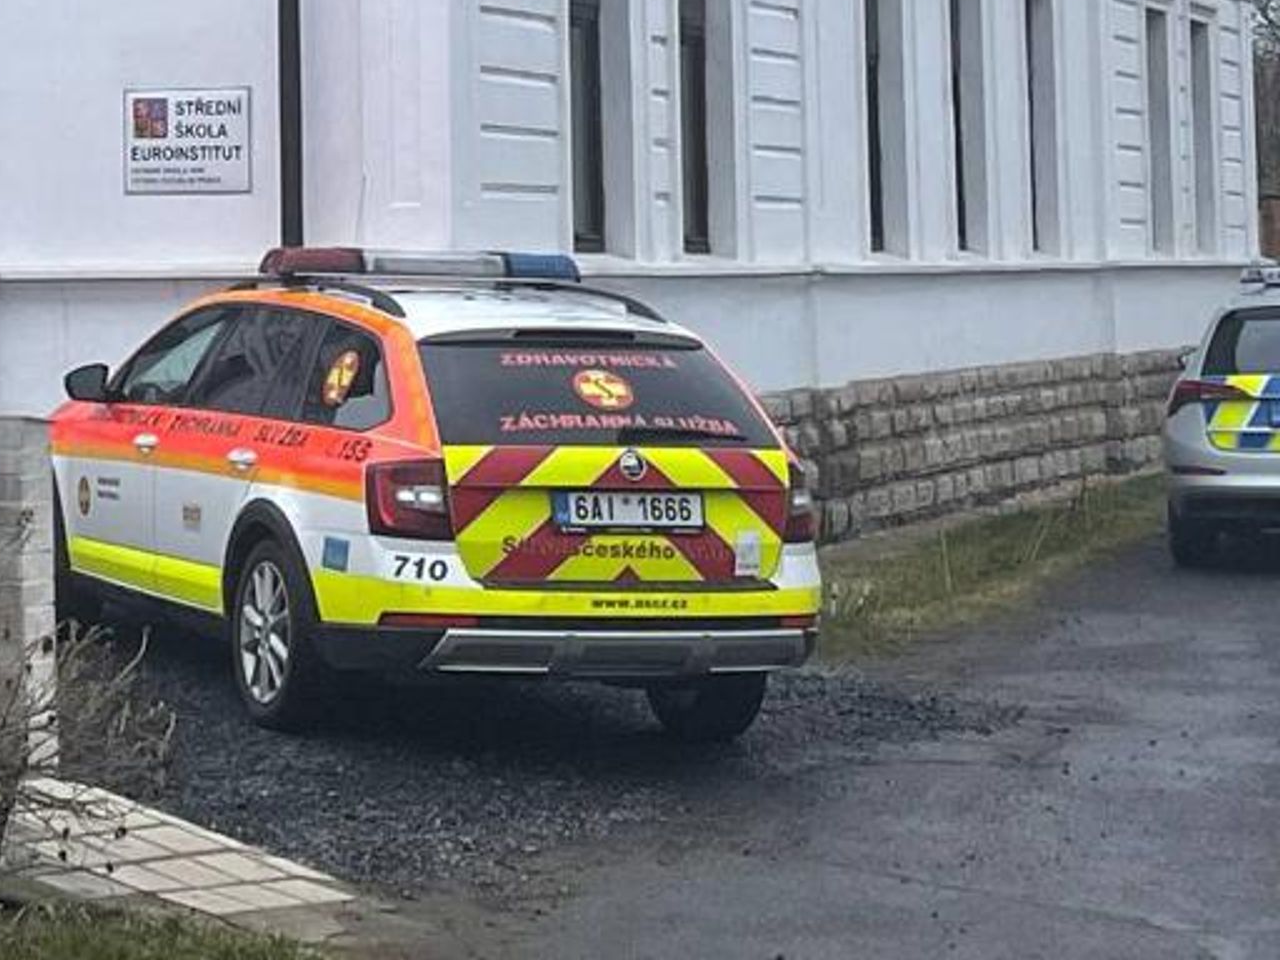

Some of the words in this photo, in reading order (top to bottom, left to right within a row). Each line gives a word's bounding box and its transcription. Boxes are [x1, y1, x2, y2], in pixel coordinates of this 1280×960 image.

[175, 97, 241, 116] STŘEDNÍ
[175, 120, 228, 139] ŠKOLA
[131, 145, 242, 161] EUROINSTITUT
[637, 497, 692, 521] 1666
[394, 555, 449, 581] 710
